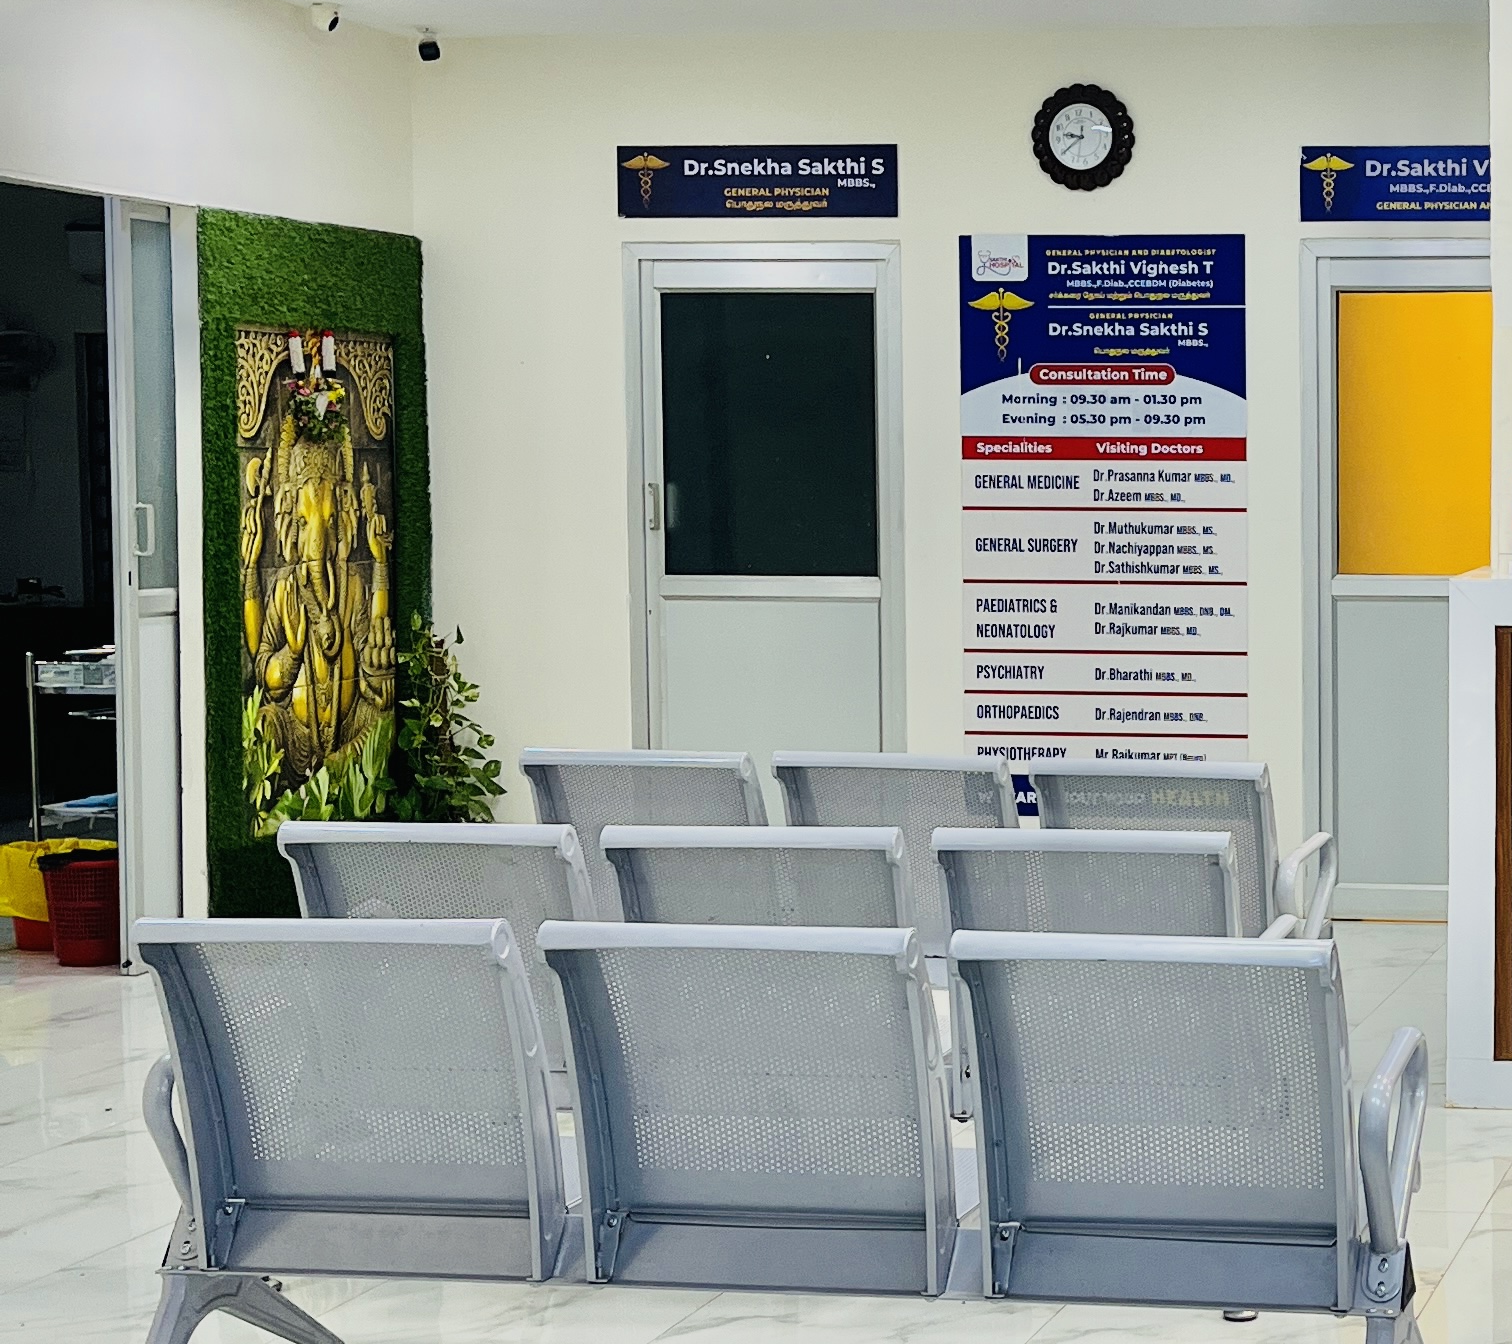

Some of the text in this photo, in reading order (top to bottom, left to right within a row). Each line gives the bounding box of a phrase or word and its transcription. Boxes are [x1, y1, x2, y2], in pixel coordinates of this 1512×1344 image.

[683, 157, 884, 175] Dr.Snekha Sakthi S
[1365, 158, 1491, 177] Dr.Sakthi V
[724, 187, 830, 196] GENERAL PHYSICIAN
[1376, 201, 1422, 210] GENERAL
[1424, 201, 1477, 210] PHYSICIAN
[1151, 248, 1217, 256] DIABETOLOGIST
[1047, 260, 1126, 275] Dr.Sakthi
[1202, 261, 1214, 275] T
[1168, 280, 1214, 289] (Diabetes)
[1048, 322, 1209, 336] Dr.Snekha Sakthi S
[1039, 368, 1167, 381] Consultation Time
[1002, 394, 1058, 408] Morning
[1070, 394, 1106, 405] 09.30
[1110, 396, 1131, 405] am
[1143, 394, 1177, 405] 01.30
[1180, 396, 1202, 408] pm
[1002, 413, 1056, 427] Evening
[1070, 414, 1106, 425] 05.30
[1109, 416, 1131, 428] pm
[1143, 414, 1180, 425] 09.30
[1184, 416, 1206, 428] pm
[976, 441, 1204, 456] Specialities Visiting Doctors
[974, 474, 1080, 490] GENERAL MEDICINE
[1093, 469, 1155, 482] Dr.Prasanna
[1158, 469, 1192, 483] Kumar
[1093, 489, 1142, 502] Dr.Azeem
[1093, 521, 1174, 535] Dr.Muthukumar
[975, 538, 1078, 553] GENERAL SURGERY
[1094, 541, 1174, 557] Dr.Nachiyappan
[1094, 561, 1180, 574] Dr.Sathishkumar
[976, 599, 1058, 614] PAEDIATRICS &
[1094, 602, 1171, 615] Dr.Manikandan
[976, 624, 1056, 639] NEONATOLOGY
[1094, 622, 1158, 637] Dr.Rajkumar
[976, 665, 1045, 680] PSYCHIATRY
[1095, 667, 1153, 681] Dr.Bharathi
[976, 705, 1060, 720] ORTHOPAEDICS
[1095, 707, 1161, 723] Dr.Rajendran
[977, 746, 1067, 761] PHYSIOTHERAPY
